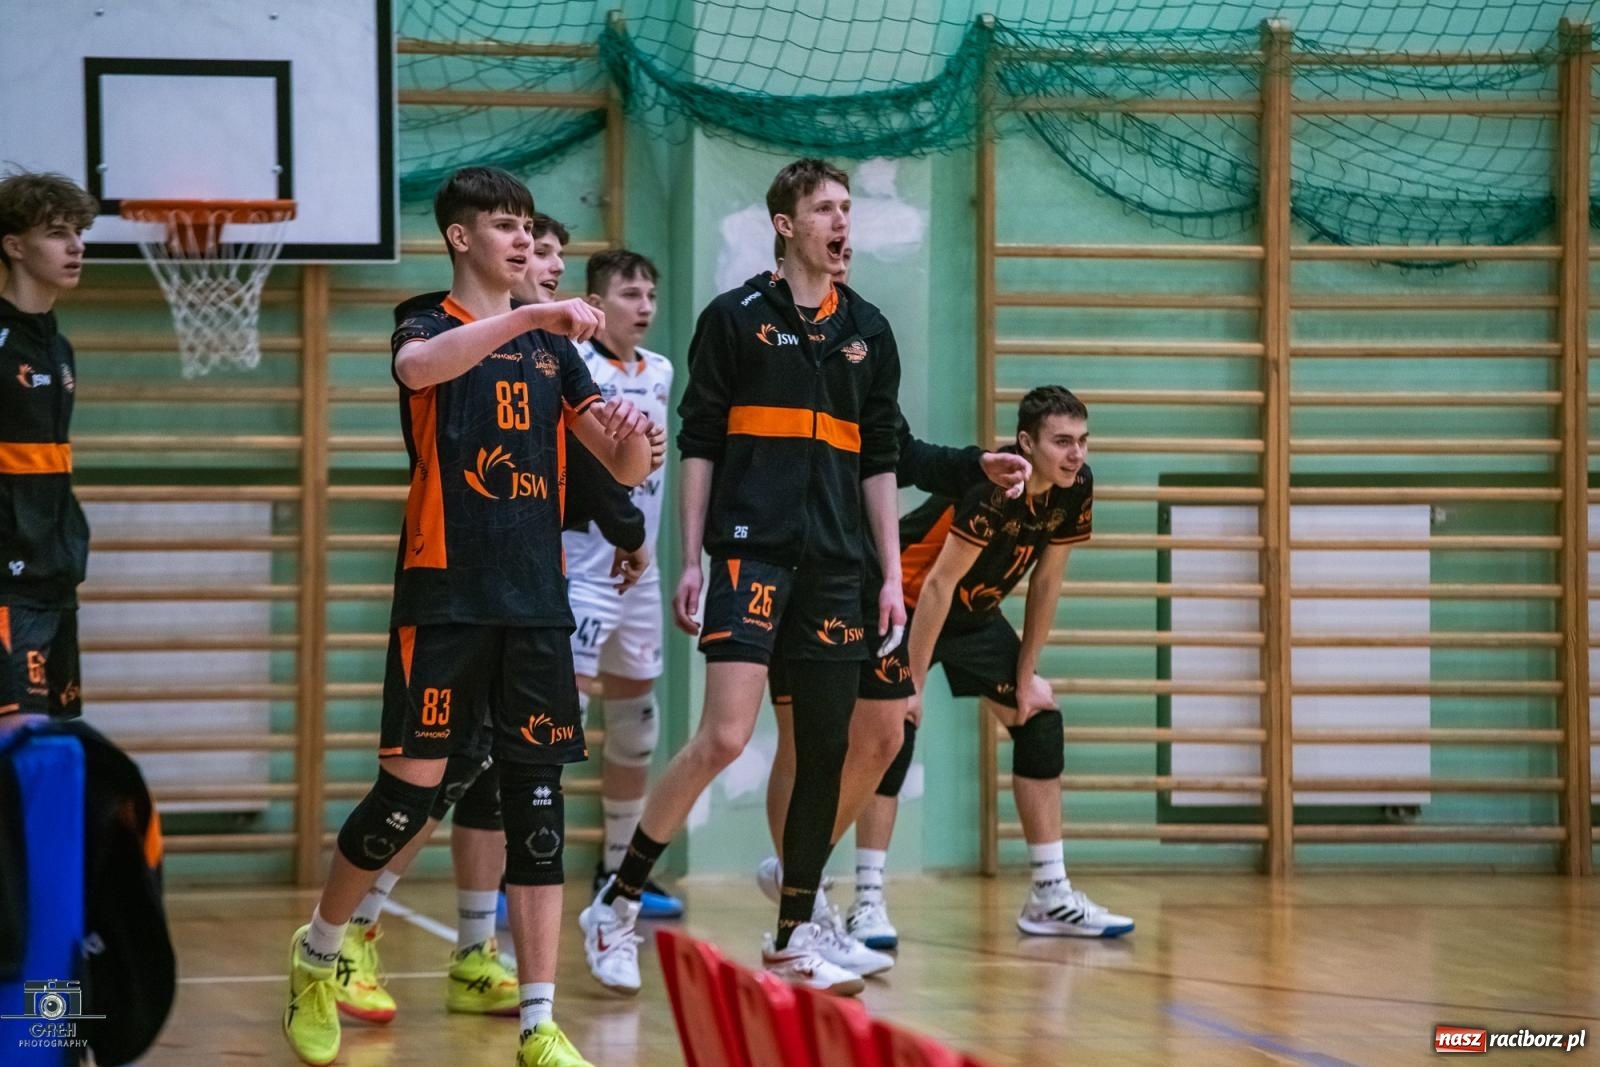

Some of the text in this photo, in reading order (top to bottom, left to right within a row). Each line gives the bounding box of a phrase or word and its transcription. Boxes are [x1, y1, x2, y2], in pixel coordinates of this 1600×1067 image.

[777, 333, 800, 346] JSW
[495, 380, 530, 431] 83
[508, 469, 549, 500] JSW
[734, 525, 749, 539] 26
[748, 581, 777, 618] 26
[577, 614, 602, 648] 47
[843, 627, 865, 646] JSW
[422, 687, 452, 726] 83
[550, 725, 574, 745] JSW
